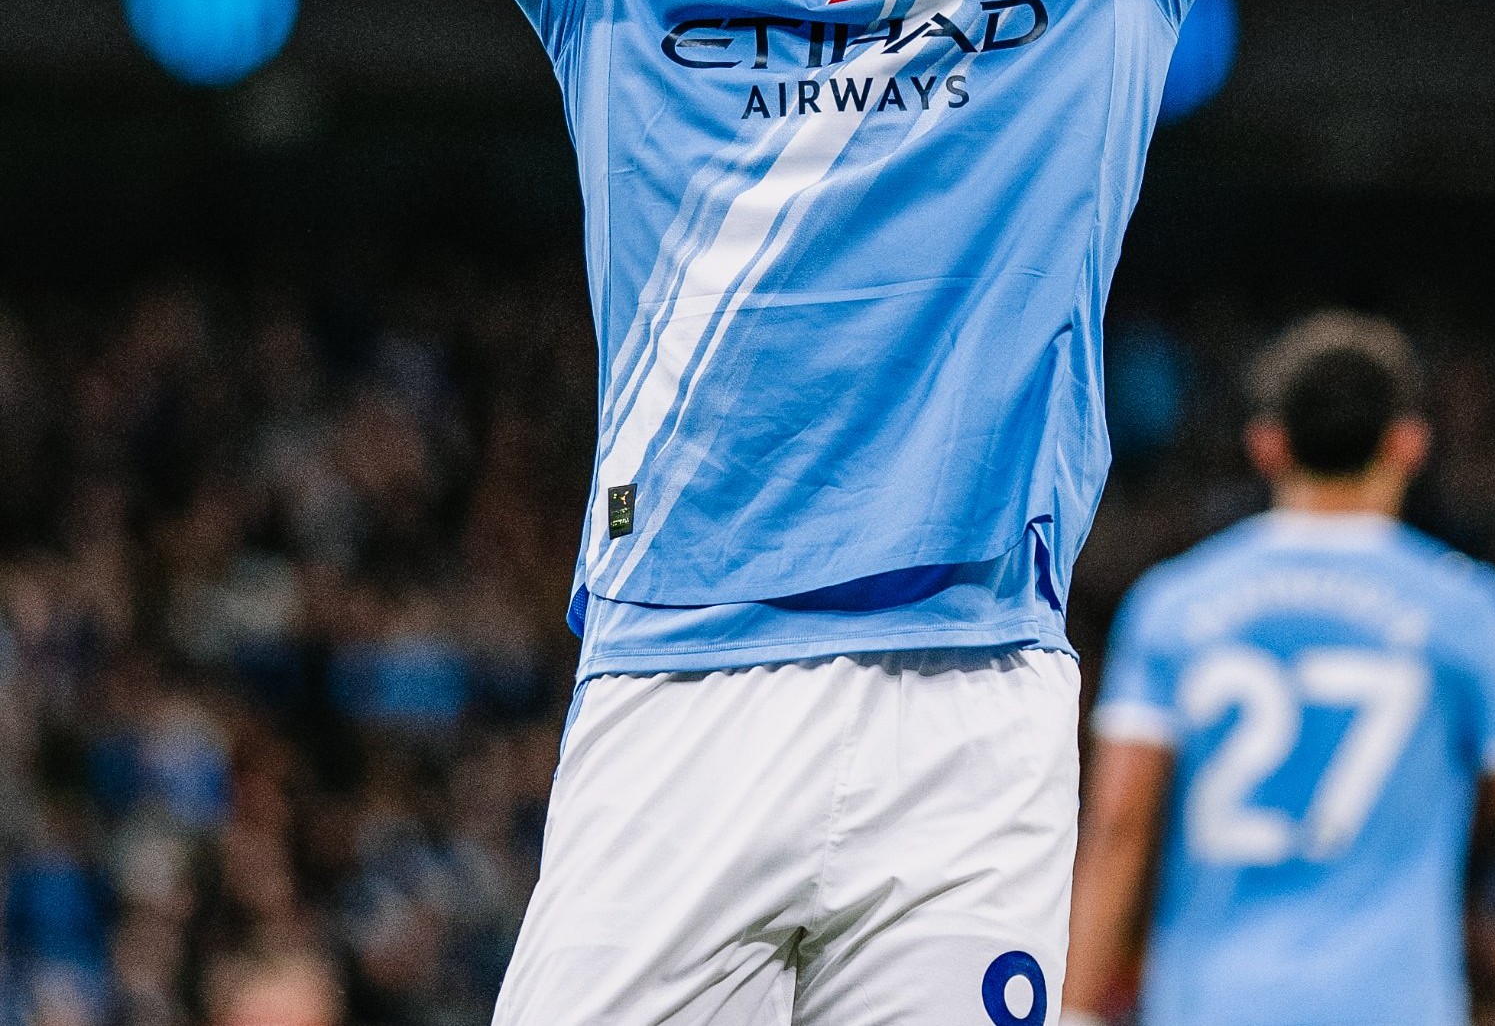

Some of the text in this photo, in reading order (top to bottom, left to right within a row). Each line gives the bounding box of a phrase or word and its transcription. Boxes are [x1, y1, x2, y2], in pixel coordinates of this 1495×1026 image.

[741, 74, 970, 120] AIRWAYS
[1180, 642, 1430, 864] 27
[981, 950, 1047, 1026] 9
